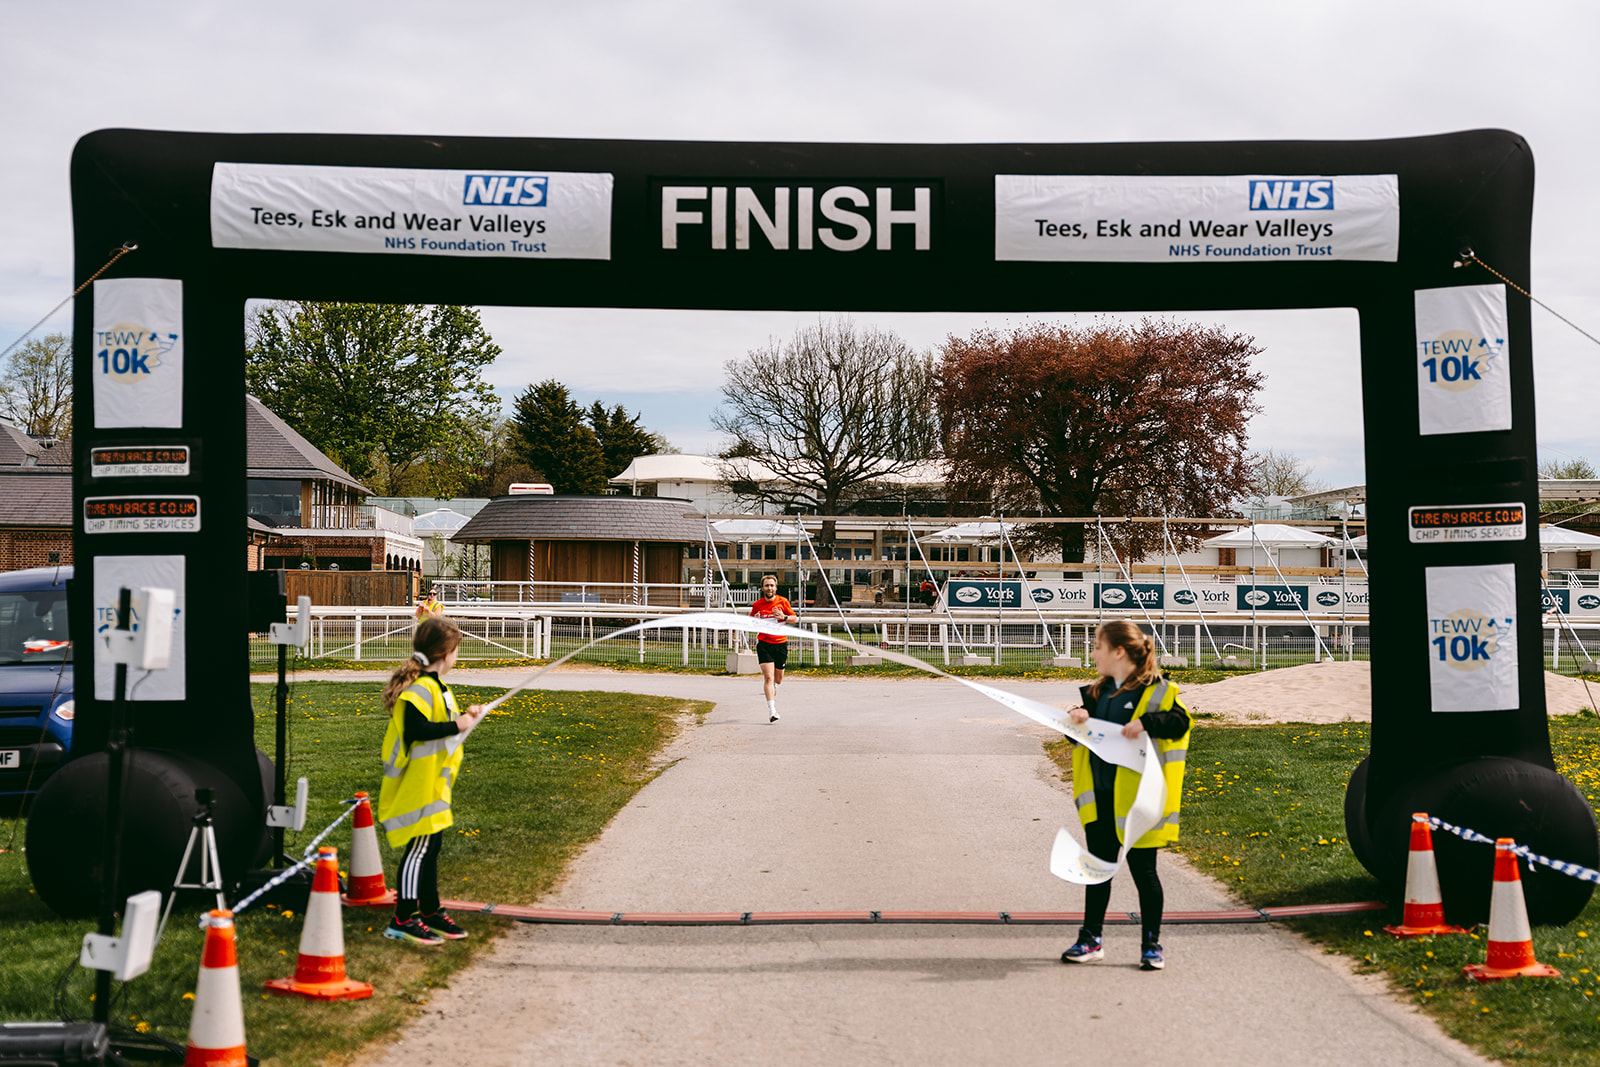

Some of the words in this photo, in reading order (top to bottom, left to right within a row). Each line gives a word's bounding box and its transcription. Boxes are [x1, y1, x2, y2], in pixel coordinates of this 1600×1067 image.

[465, 176, 546, 205] NHS
[1251, 181, 1331, 209] NHS
[251, 207, 303, 228] Tees,
[312, 210, 347, 228] Esk
[354, 211, 395, 229] and
[403, 213, 462, 231] Wear
[469, 214, 546, 237] Valleys
[662, 186, 931, 251] FINISH
[1035, 219, 1088, 239] Tees,
[1096, 219, 1132, 237] Esk
[1139, 219, 1181, 237] and
[1189, 220, 1248, 237] Wear
[1256, 218, 1333, 241] Valleys
[385, 237, 416, 248] NHS
[421, 238, 505, 252] Foundation
[510, 240, 547, 253] Trust
[1169, 244, 1200, 256] NHS
[1205, 244, 1290, 256] Foundation
[1296, 244, 1332, 256] Trust
[97, 332, 143, 346] TEWV
[1420, 338, 1472, 355] TEWV
[98, 348, 150, 374] 10k
[1422, 355, 1482, 382] 10k
[142, 464, 185, 474] SERVICES
[88, 520, 106, 531] CHIP
[109, 520, 140, 530] TIMING
[143, 519, 194, 529] SERVICES
[1416, 530, 1440, 540] CHIP
[1444, 528, 1477, 539] TIMING
[1480, 527, 1522, 538] SERVICES
[984, 588, 1014, 599] York
[1058, 588, 1087, 600] York
[1130, 588, 1158, 600] York
[1202, 590, 1230, 602] York
[1430, 618, 1482, 634] TEWV
[1432, 634, 1490, 662] 10k
